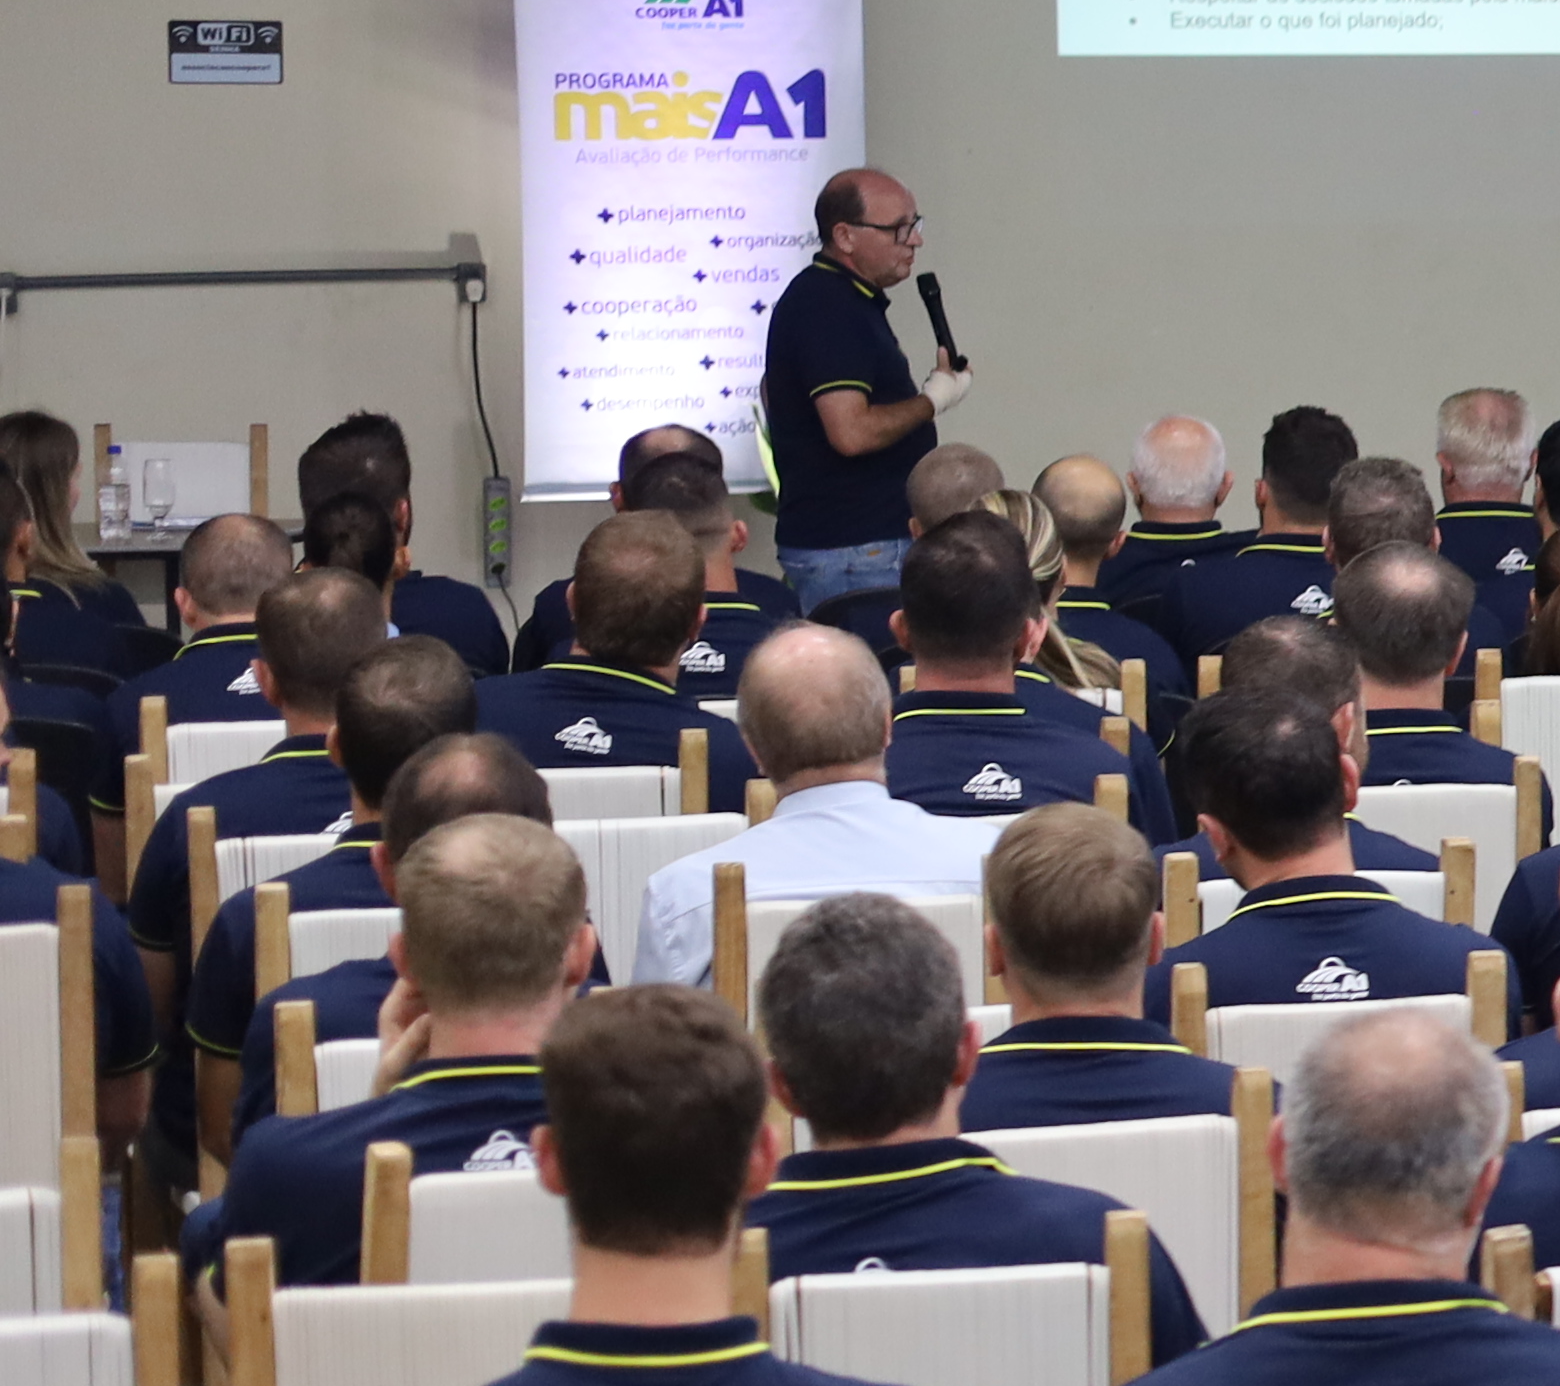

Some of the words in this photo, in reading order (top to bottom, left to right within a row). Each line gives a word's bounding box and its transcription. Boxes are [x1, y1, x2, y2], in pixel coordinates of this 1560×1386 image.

[636, 7, 697, 19] COOPER
[555, 73, 668, 89] PROGRAMA
[575, 148, 661, 167] Avaliação
[667, 148, 688, 163] de
[695, 146, 808, 163] Performance
[618, 205, 745, 225] planejamento
[589, 247, 687, 268] qualidade
[712, 265, 780, 283] vendas
[582, 295, 697, 317] cooperação
[613, 325, 744, 341] relacionamento
[573, 365, 674, 378] atendimento
[597, 394, 705, 411] desempenho
[1340, 973, 1369, 991] A1
